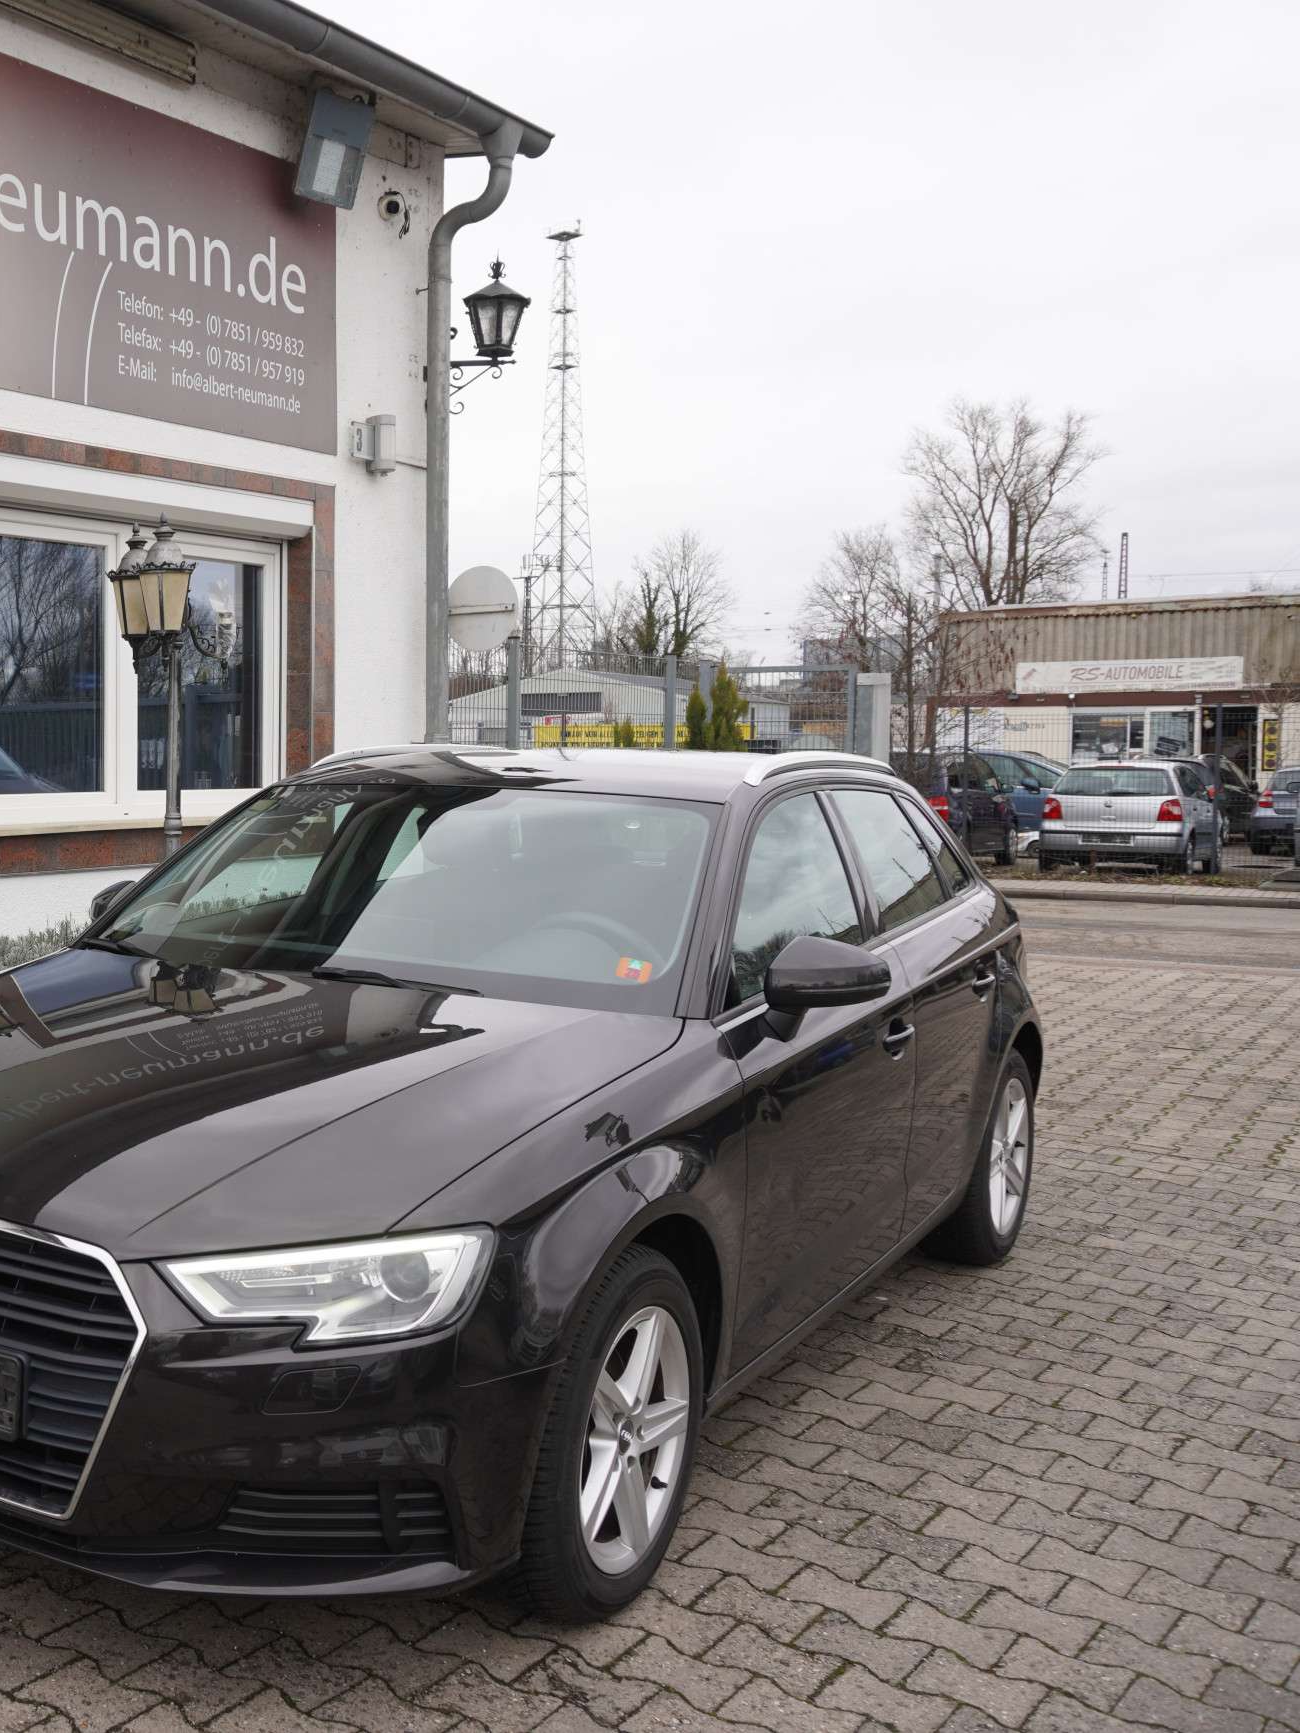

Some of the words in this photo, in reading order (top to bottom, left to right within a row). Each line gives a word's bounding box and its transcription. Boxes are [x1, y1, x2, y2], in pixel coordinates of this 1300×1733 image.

[117, 290, 164, 321] Telefon:
[206, 312, 222, 338] (0)
[224, 319, 251, 344] 7851
[262, 329, 282, 352] 959
[284, 336, 305, 358] 832
[117, 322, 162, 352] Telefax:
[206, 344, 222, 369] (0)
[224, 350, 251, 374] 7851
[262, 360, 282, 381] 957
[285, 366, 305, 387] 919
[118, 354, 157, 382] E-Mail:
[171, 366, 302, 415] info@albert-neumann.de
[1070, 663, 1184, 681] RS-AUTOMOBILE
